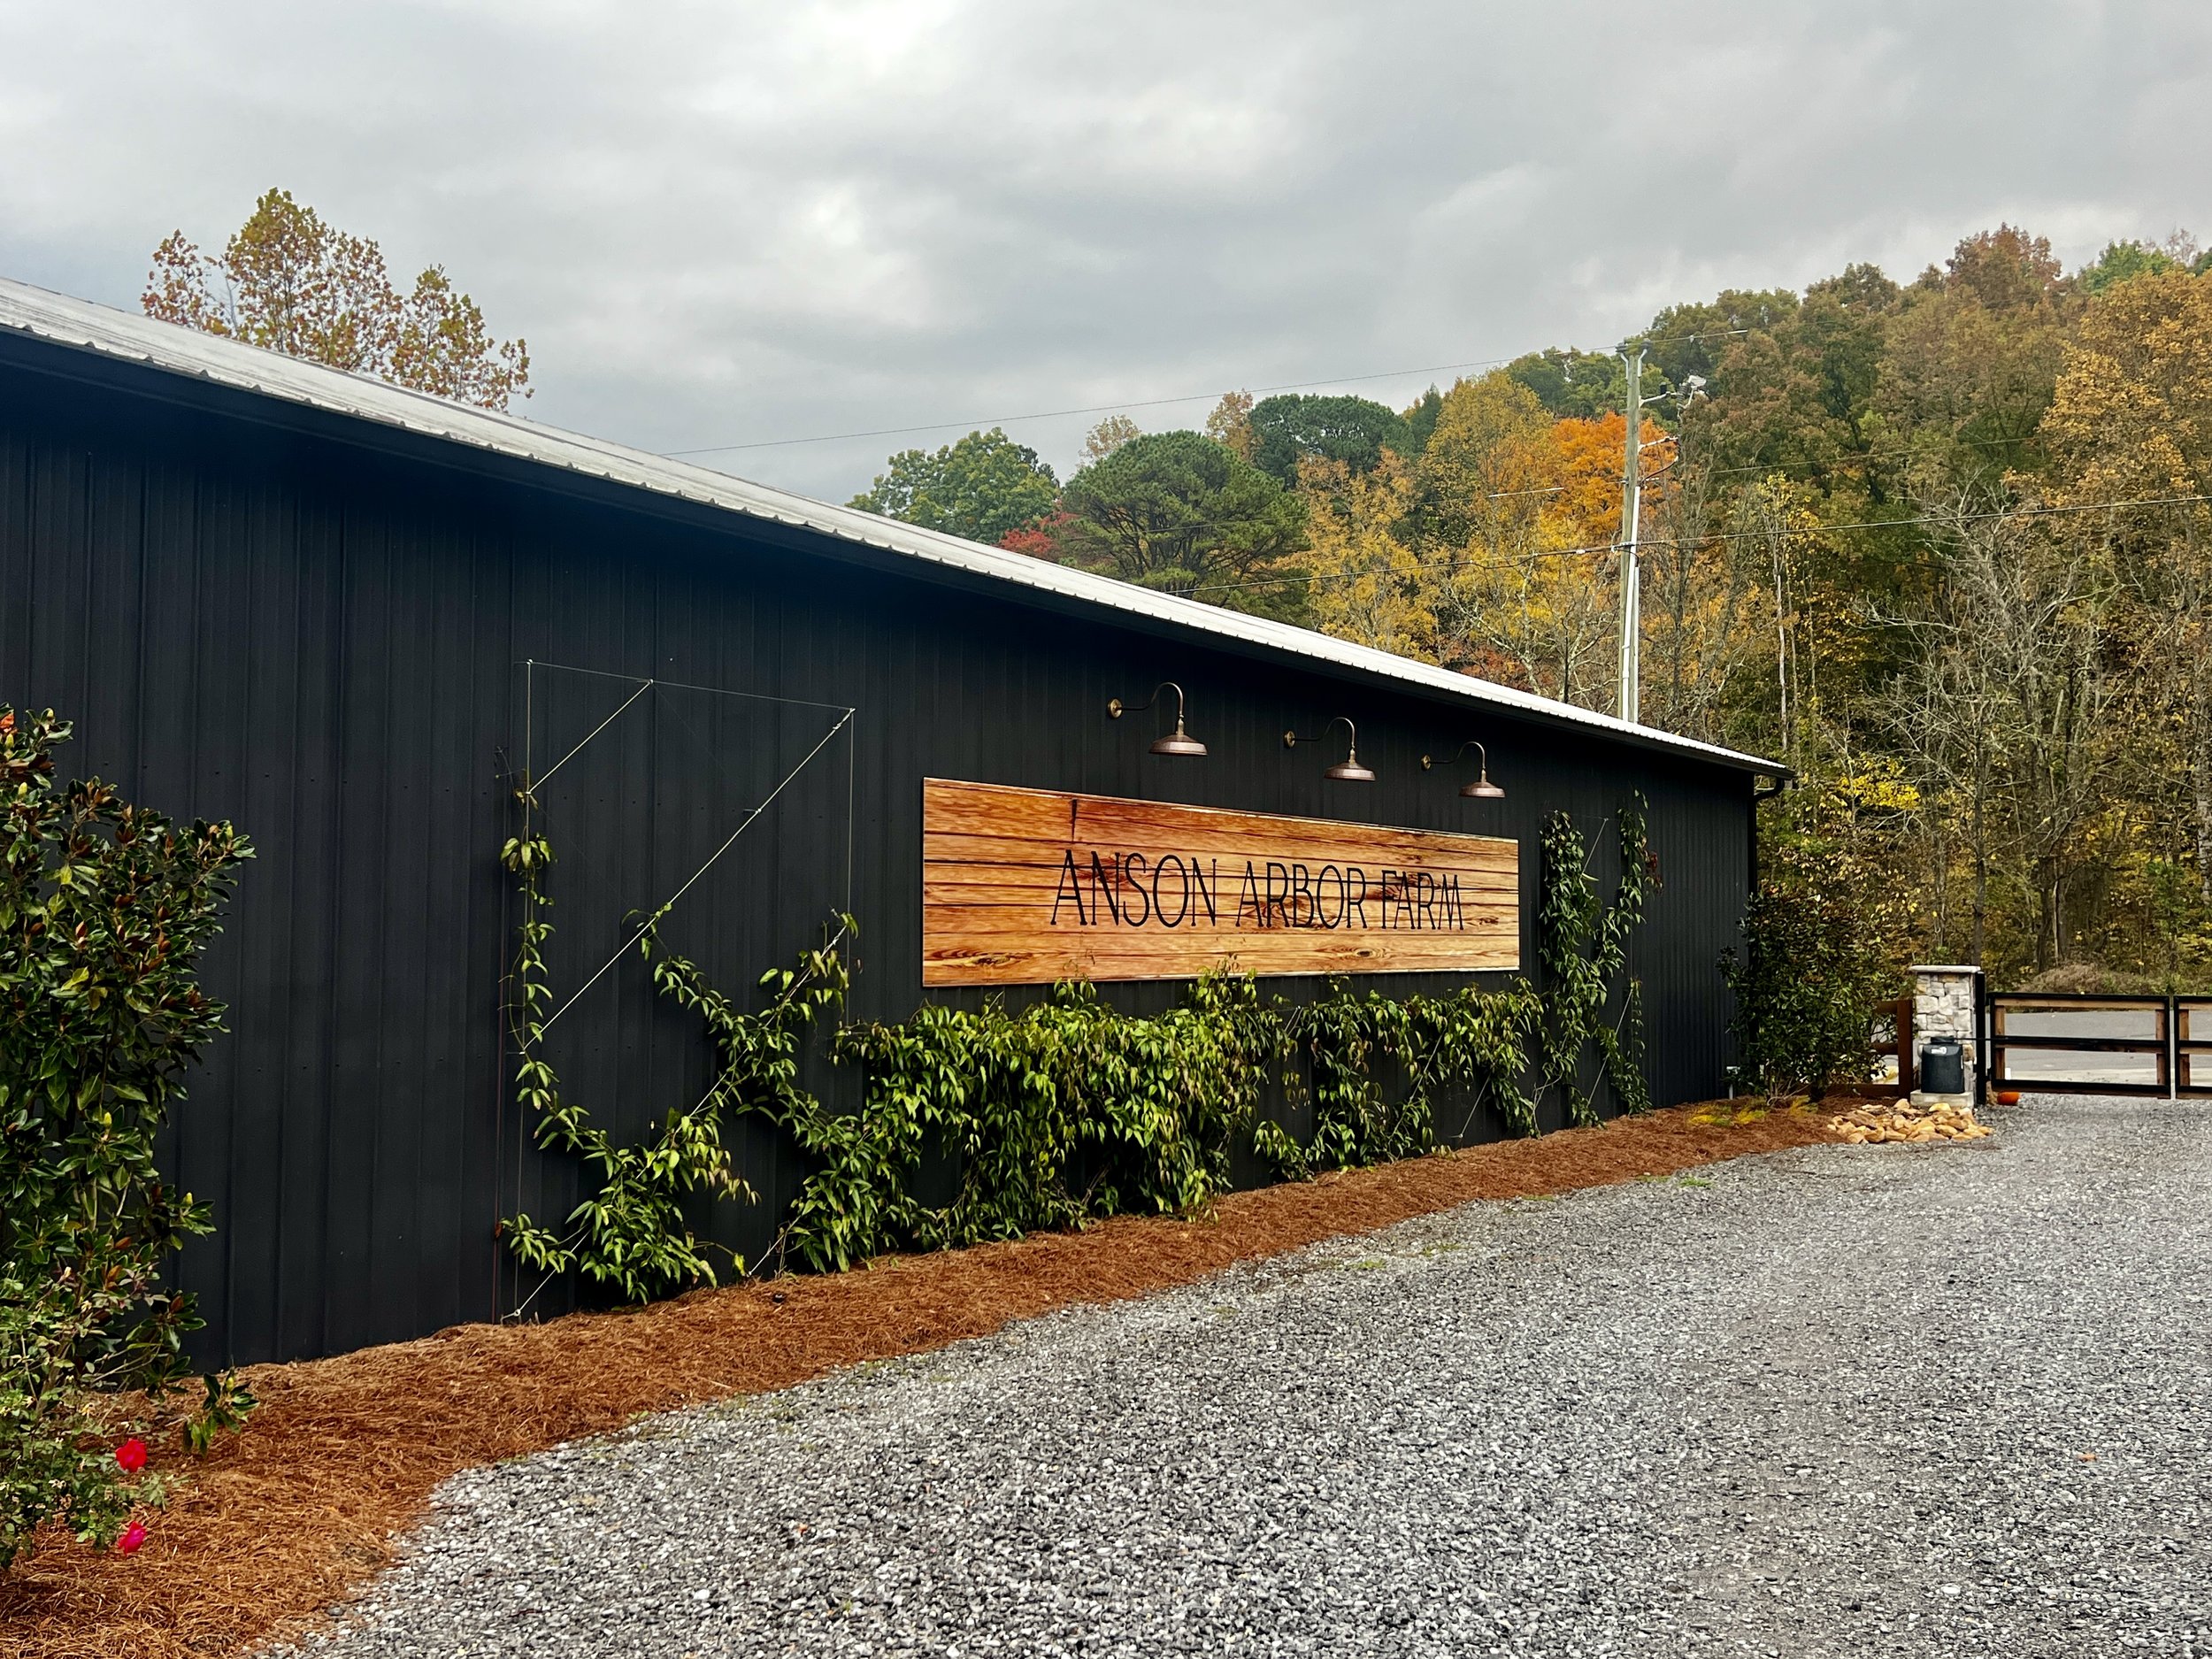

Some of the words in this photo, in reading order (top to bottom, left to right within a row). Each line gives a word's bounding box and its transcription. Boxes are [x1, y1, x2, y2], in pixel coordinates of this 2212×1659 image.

[1050, 849, 1217, 927] ANSON
[1235, 860, 1368, 929] ARBOR
[1381, 870, 1464, 931] FARM
